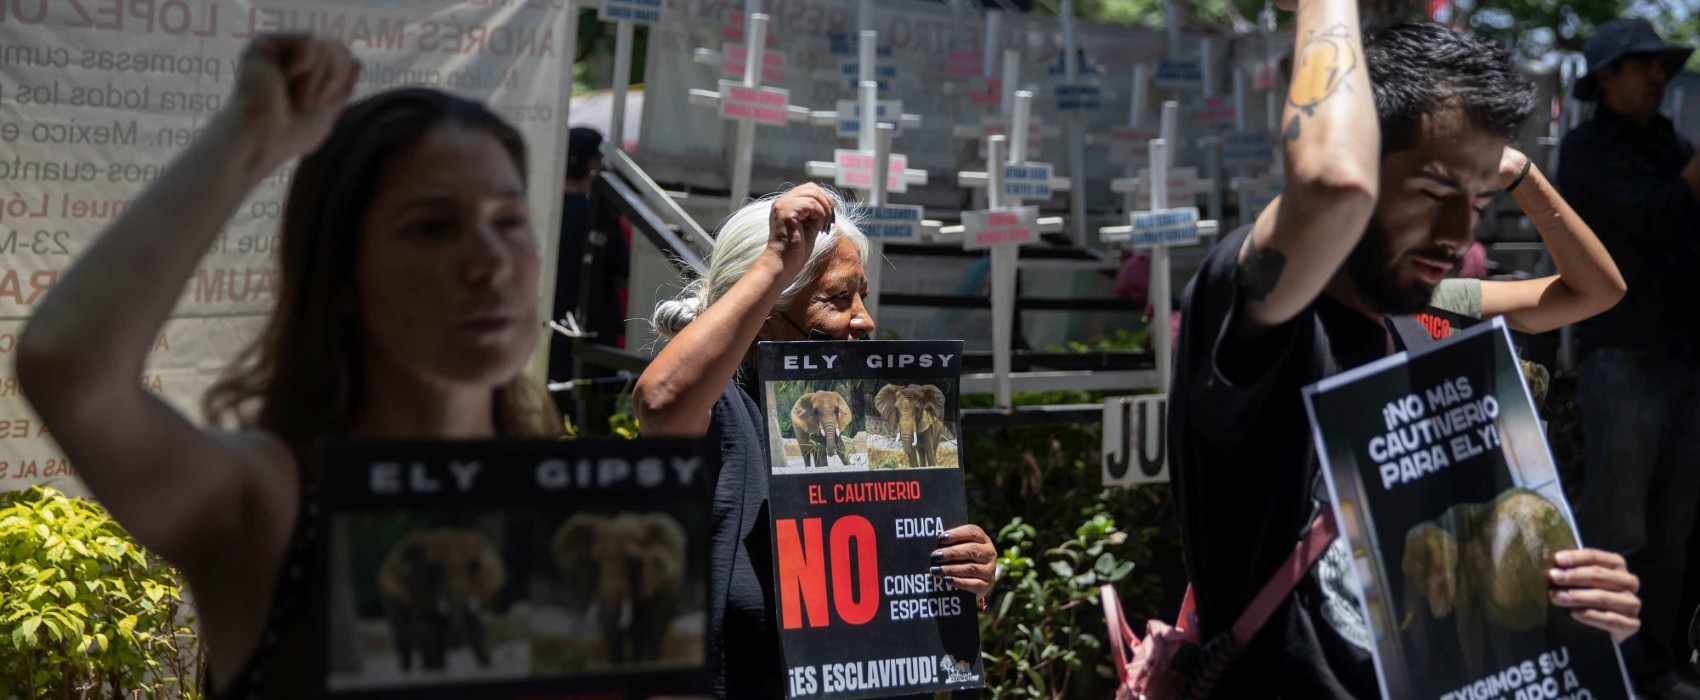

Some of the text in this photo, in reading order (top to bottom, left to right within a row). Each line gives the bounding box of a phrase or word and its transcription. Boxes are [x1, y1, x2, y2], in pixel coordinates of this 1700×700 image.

[1411, 311, 1450, 339] GICO
[783, 353, 955, 370] ELY GIPSY
[1382, 394, 1424, 431] ¡NO
[1368, 395, 1499, 462] CAUTIVERIO
[1379, 424, 1500, 490] PARA ELY!
[368, 455, 703, 494] ELY GIPSY
[808, 481, 921, 504] EL CAUTIVERIO
[895, 516, 945, 538] EDUCA
[775, 515, 880, 630] NO
[884, 573, 959, 596] CONSERV
[890, 596, 962, 621] ESPECIES
[1538, 646, 1569, 675] SU
[788, 655, 939, 697] ¡ES ESCLAVITUD!
[1563, 669, 1580, 691] A
